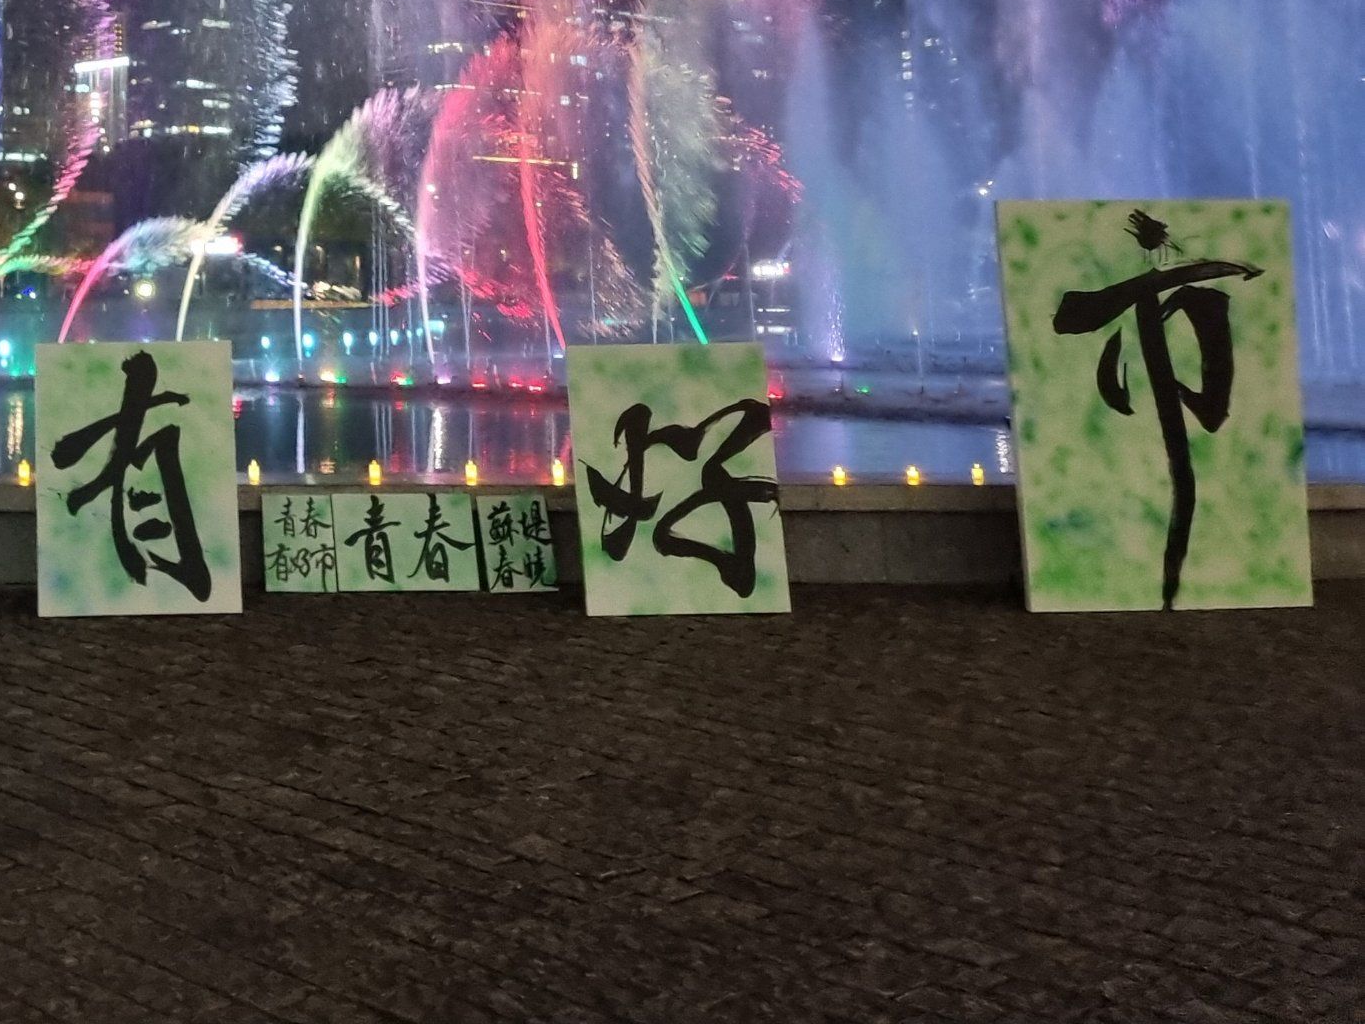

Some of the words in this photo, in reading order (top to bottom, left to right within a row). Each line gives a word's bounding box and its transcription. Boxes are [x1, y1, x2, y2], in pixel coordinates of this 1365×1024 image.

[51, 350, 212, 602] 有
[578, 399, 780, 598] 好
[1052, 208, 1265, 611] 市
[274, 497, 332, 538] 青春
[344, 492, 475, 583] 青春
